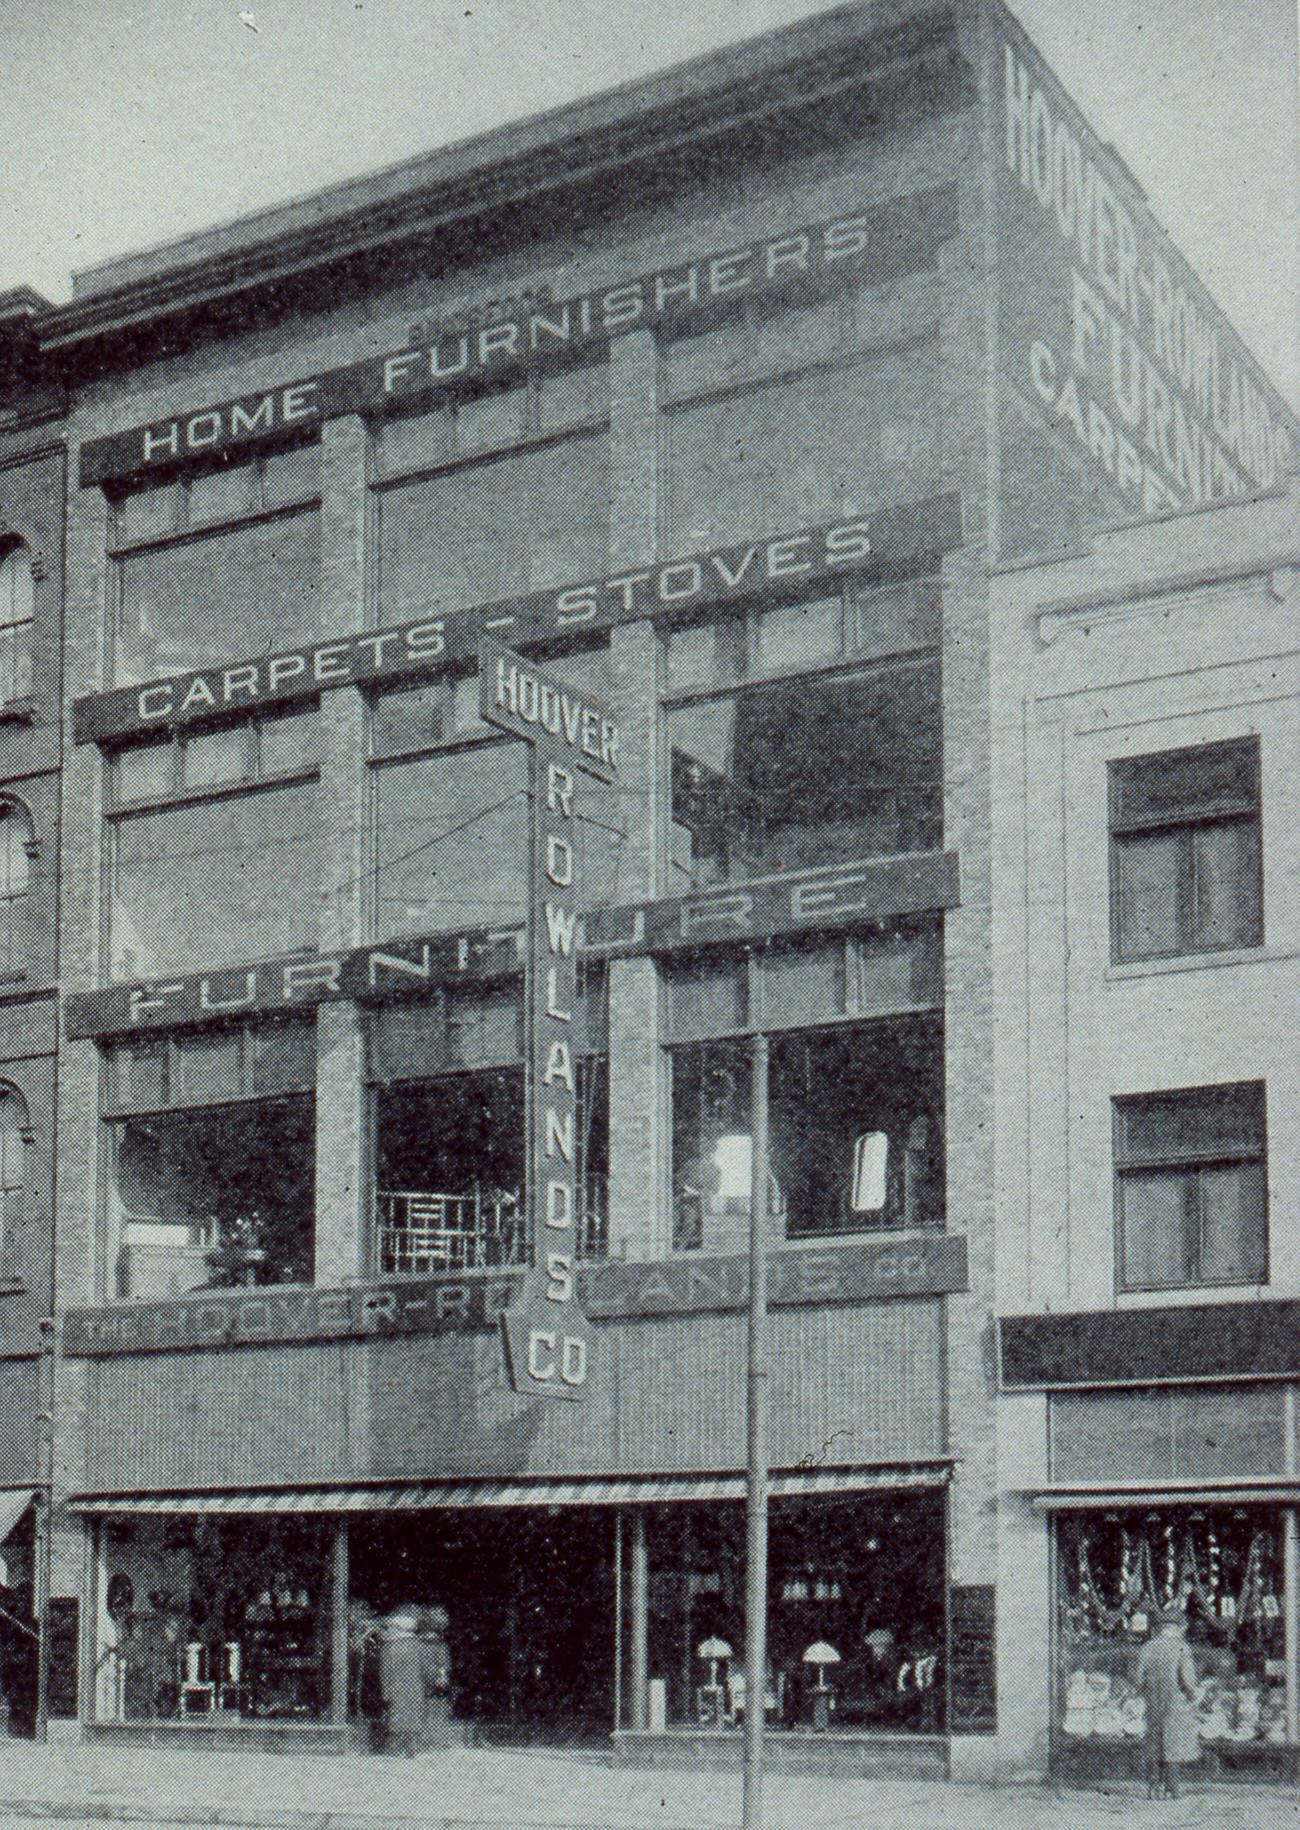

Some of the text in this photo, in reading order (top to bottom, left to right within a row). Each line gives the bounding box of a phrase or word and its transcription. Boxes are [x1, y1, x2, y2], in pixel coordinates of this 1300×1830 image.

[142, 217, 870, 462] HOME FURNISHERS
[137, 620, 446, 721] CARPETS
[556, 521, 872, 627] STOVES
[496, 656, 620, 770] HOOVER
[130, 874, 868, 1024] FURNITURE
[542, 763, 578, 1302] ROWLANDS
[83, 1253, 926, 1340] THE HOOVER-ROLANDS CO
[527, 1329, 587, 1386] CO
